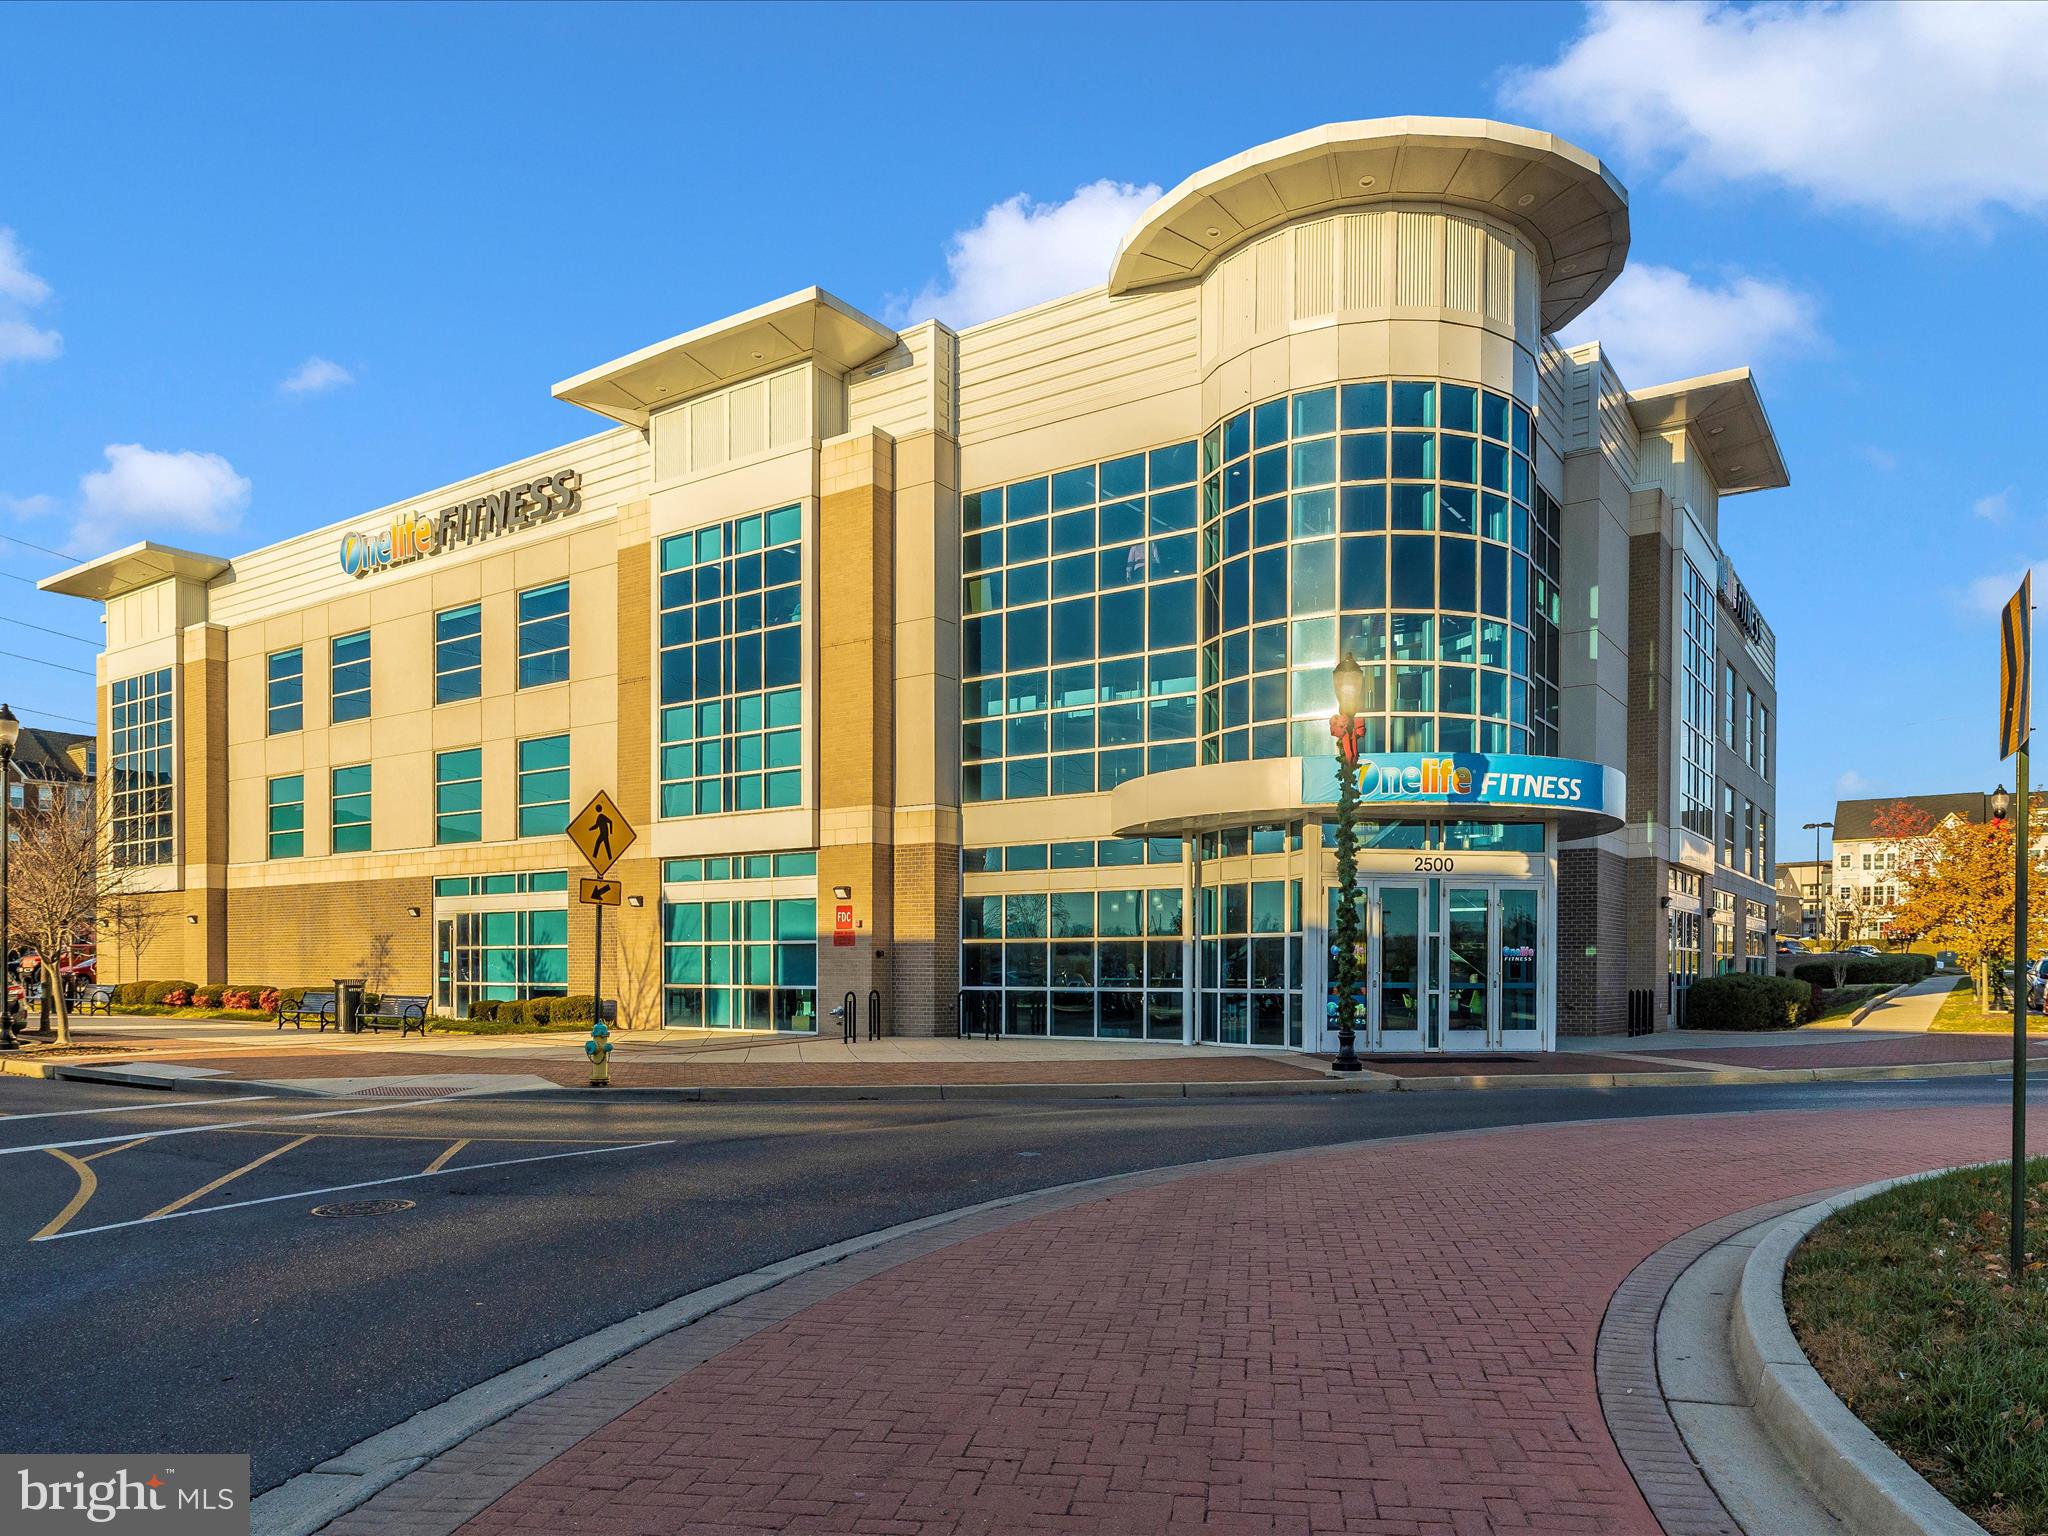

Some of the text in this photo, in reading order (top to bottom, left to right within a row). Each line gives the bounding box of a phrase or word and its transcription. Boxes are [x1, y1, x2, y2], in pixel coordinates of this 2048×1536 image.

[340, 469, 578, 576] Onelife FITNESS
[1356, 758, 1582, 800] Onelife FITNESS
[1414, 857, 1454, 872] 2500
[837, 911, 851, 922] FDC
